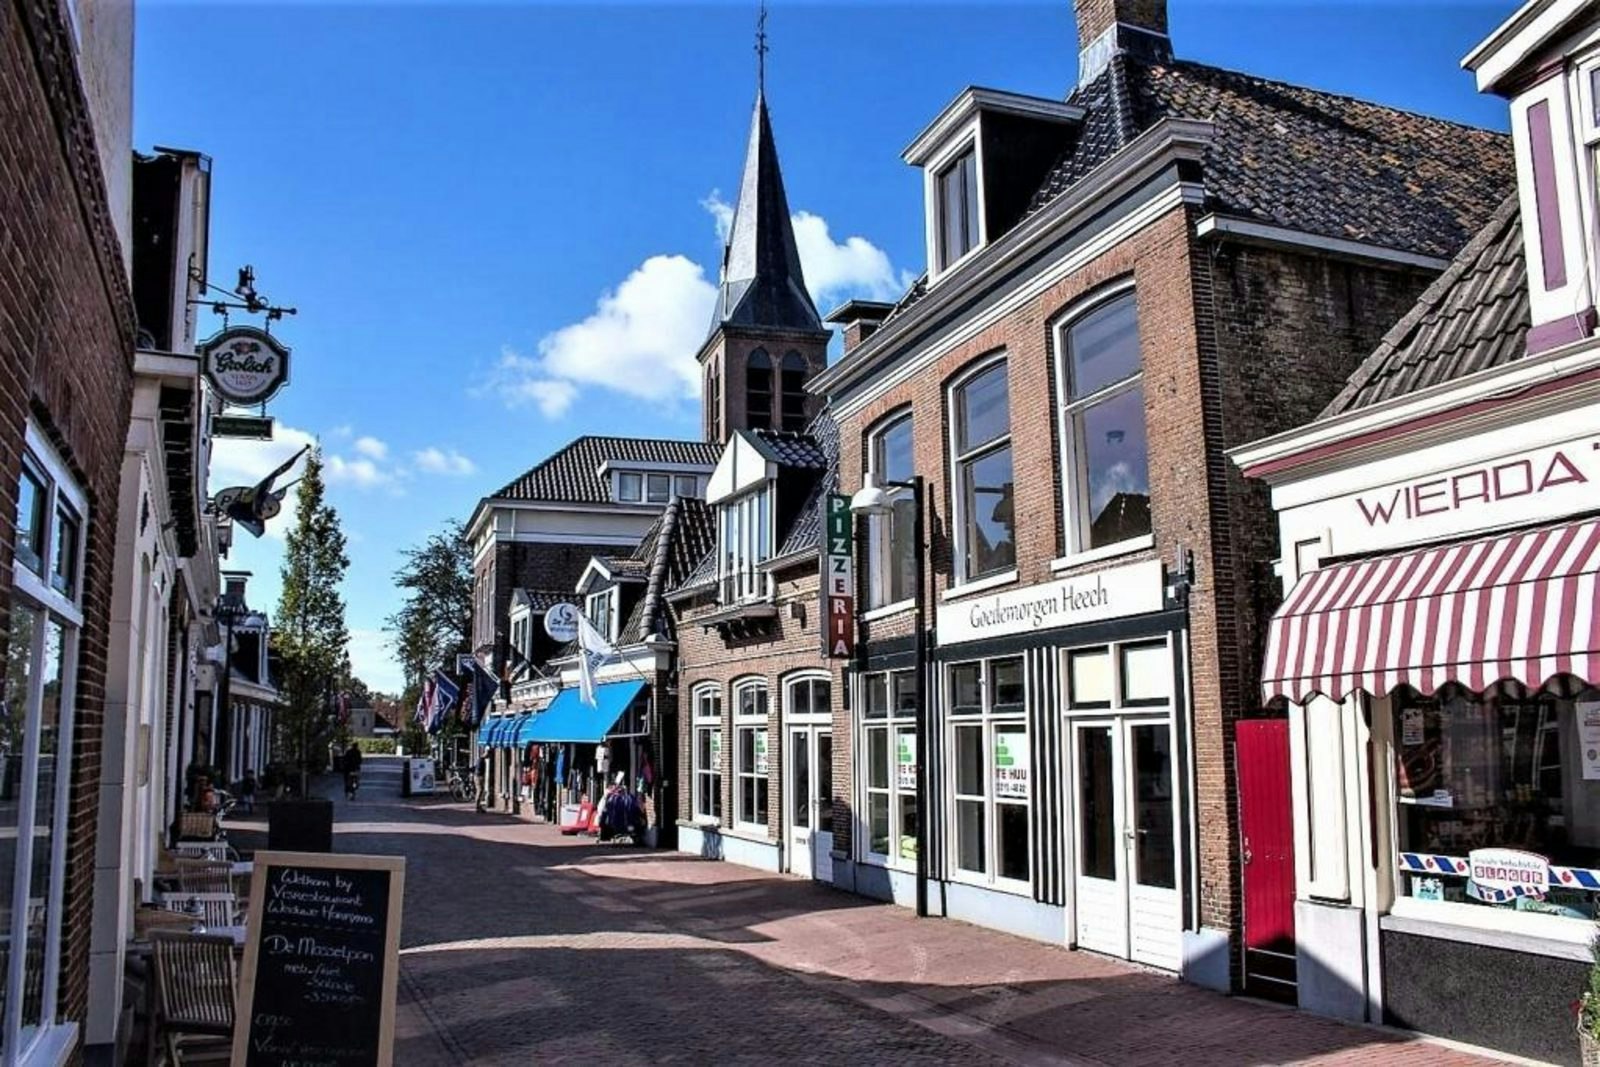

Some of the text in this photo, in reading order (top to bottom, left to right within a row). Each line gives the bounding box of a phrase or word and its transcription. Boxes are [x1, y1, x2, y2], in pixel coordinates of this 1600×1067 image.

[215, 352, 274, 373] Grolsch
[832, 498, 849, 655] PIZZERIA
[970, 575, 1108, 628] Goedemorgen Heech
[281, 868, 330, 887] Welkom
[1474, 866, 1543, 884] SLAGER
[263, 934, 296, 955] De
